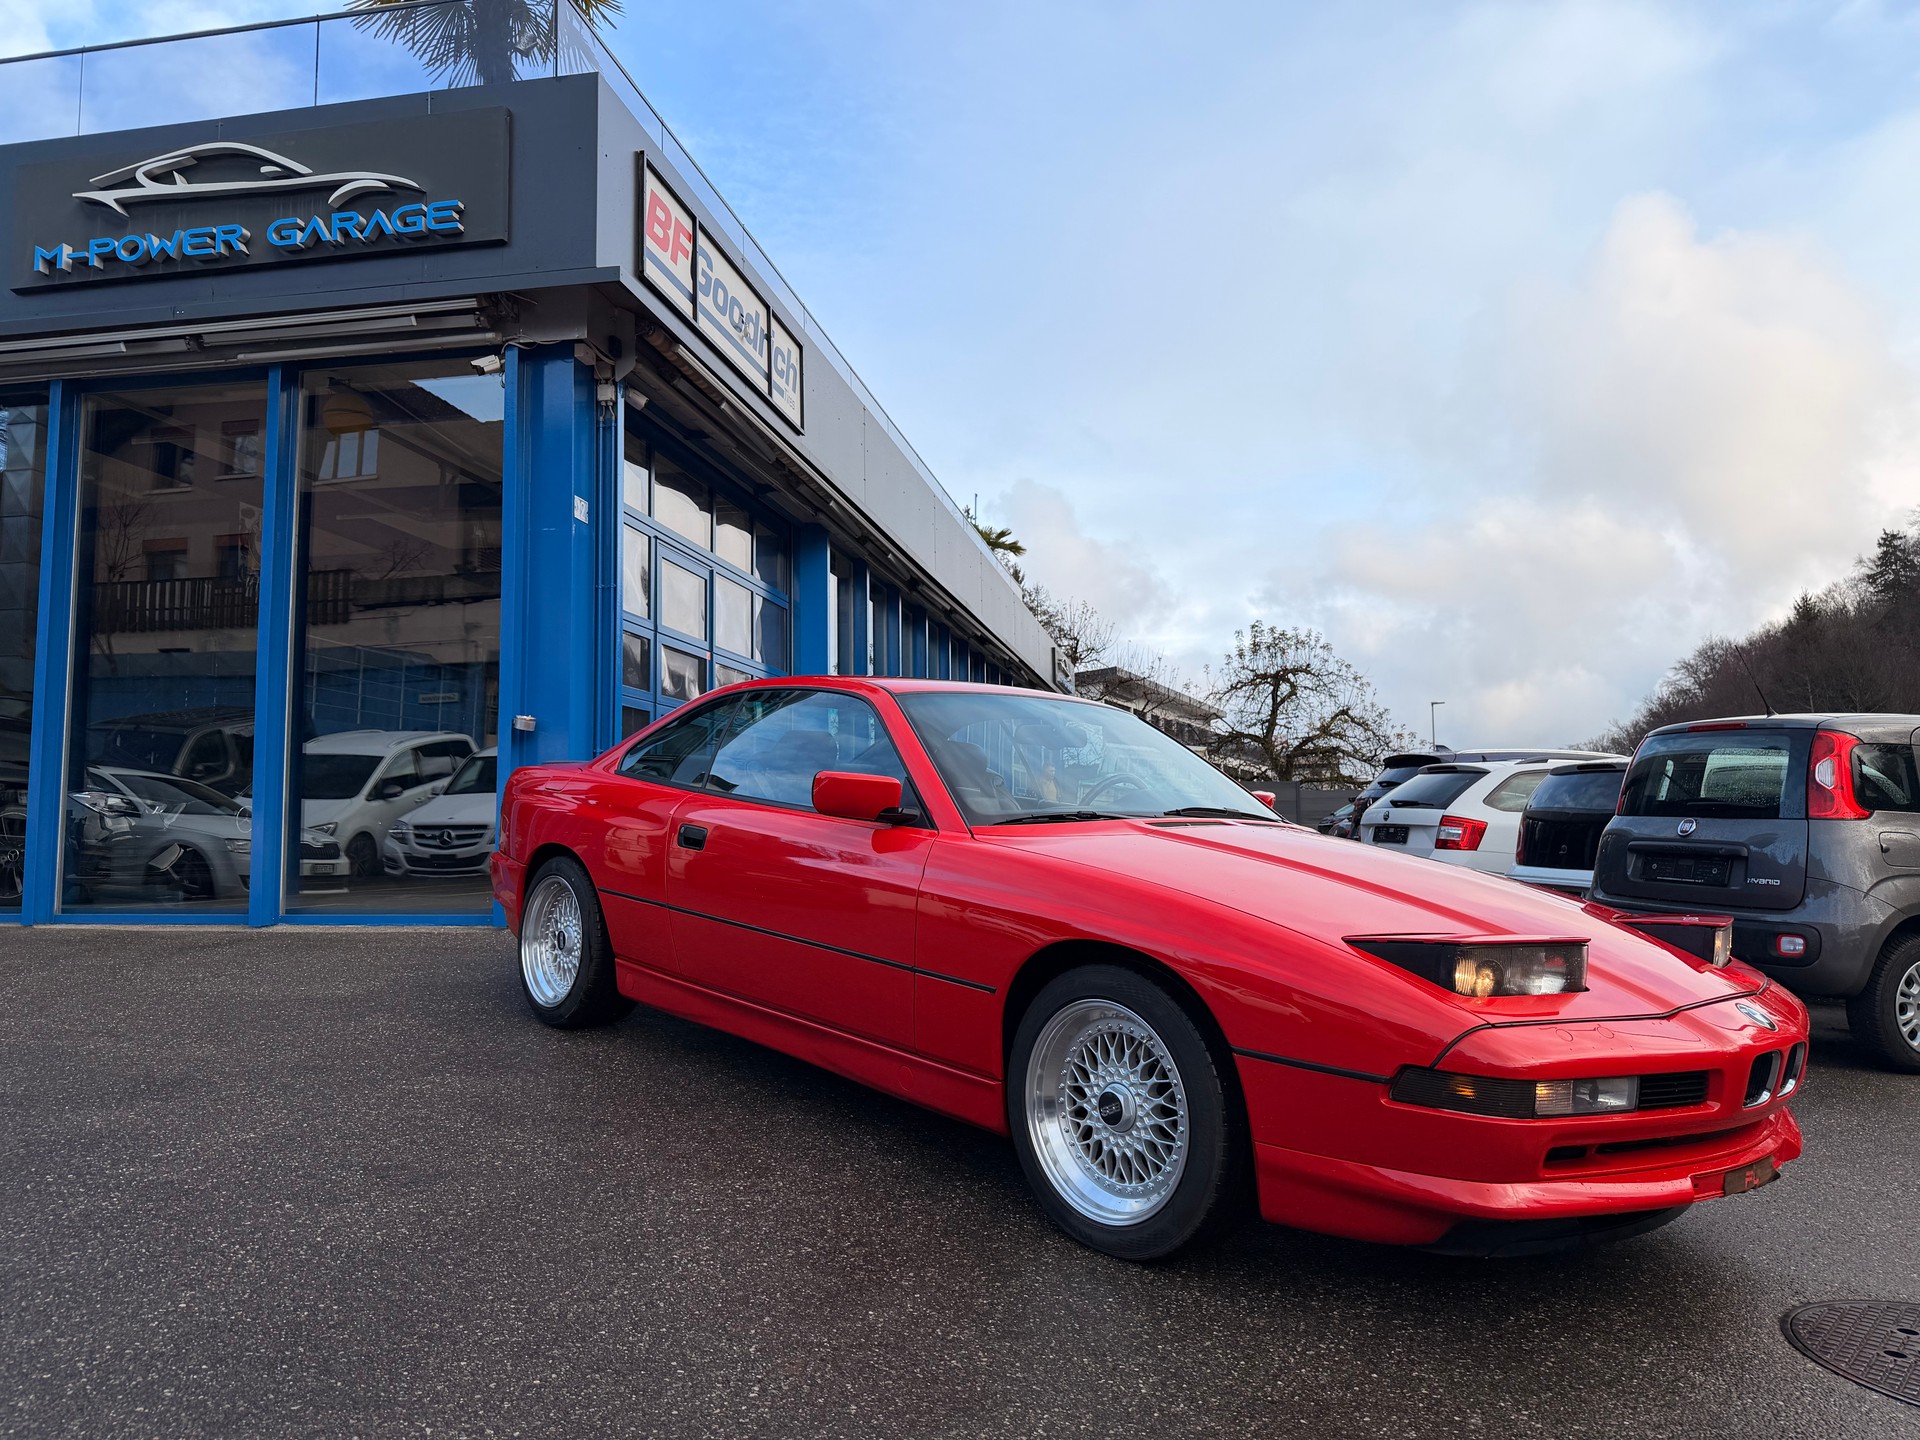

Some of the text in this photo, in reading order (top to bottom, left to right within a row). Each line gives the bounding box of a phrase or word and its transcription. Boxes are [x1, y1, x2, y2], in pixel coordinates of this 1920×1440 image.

[34, 200, 464, 274] M-POWER GARAGE
[1747, 878, 1780, 886] HYBRID
